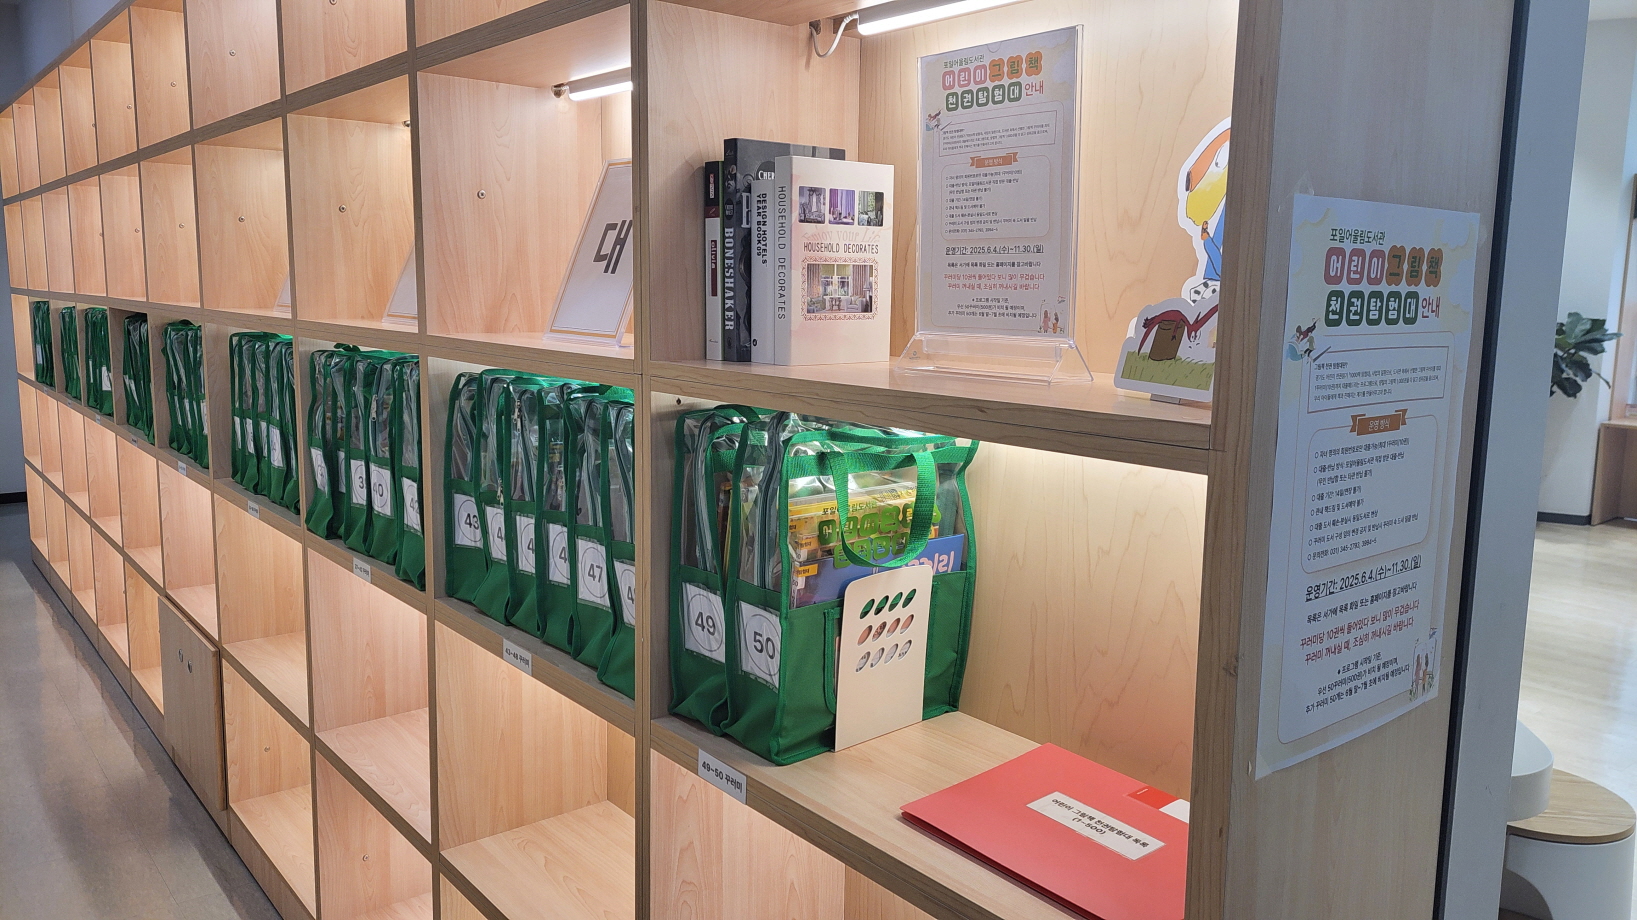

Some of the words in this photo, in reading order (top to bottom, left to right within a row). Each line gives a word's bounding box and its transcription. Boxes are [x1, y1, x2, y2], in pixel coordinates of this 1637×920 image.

[947, 82, 1020, 110] 천권탐험대
[1024, 80, 1043, 96] 안내
[778, 186, 786, 249] HOUSEHOLD
[837, 230, 860, 242] your
[1329, 227, 1386, 245] 포일어울림도서관
[803, 242, 840, 253] HOUSEHOLD
[843, 243, 879, 254] DECORATES
[724, 227, 734, 330] BONESHAKER
[777, 258, 786, 320] DECORATES
[1326, 293, 1418, 323] 천권탐험대
[1420, 295, 1441, 318] 안내
[1368, 419, 1379, 431] 운영
[1379, 418, 1390, 430] 방식
[821, 501, 877, 515] 포일림도서관
[464, 513, 479, 530] 43
[497, 527, 504, 542] 4
[527, 538, 535, 554] 4
[559, 546, 567, 564] 4
[588, 563, 603, 583] 47
[1305, 577, 1338, 602] 운영기간:
[1339, 553, 1422, 592] 2025.6.4.(수)~11.30.(일)
[1358, 595, 1369, 608] 또는
[695, 611, 716, 636] 49
[1300, 629, 1325, 650] 꾸러미당
[1326, 623, 1345, 641] 10권씩
[1346, 615, 1369, 634] 들어있다
[1369, 611, 1381, 626] 보니
[1382, 607, 1393, 622] 많이
[1393, 598, 1419, 618] 무겁습니다
[753, 631, 776, 660] 50
[1304, 647, 1323, 666] 꾸러미
[1352, 631, 1369, 648] 조심히
[1392, 615, 1414, 634] 바랍니다
[702, 761, 723, 780] 49~50
[725, 774, 742, 793] 꾸러미
[1051, 798, 1074, 811] 어린이
[1072, 809, 1096, 822] 그림책
[1095, 819, 1133, 840] 천권탐험대
[1072, 817, 1107, 835] (1~500)
